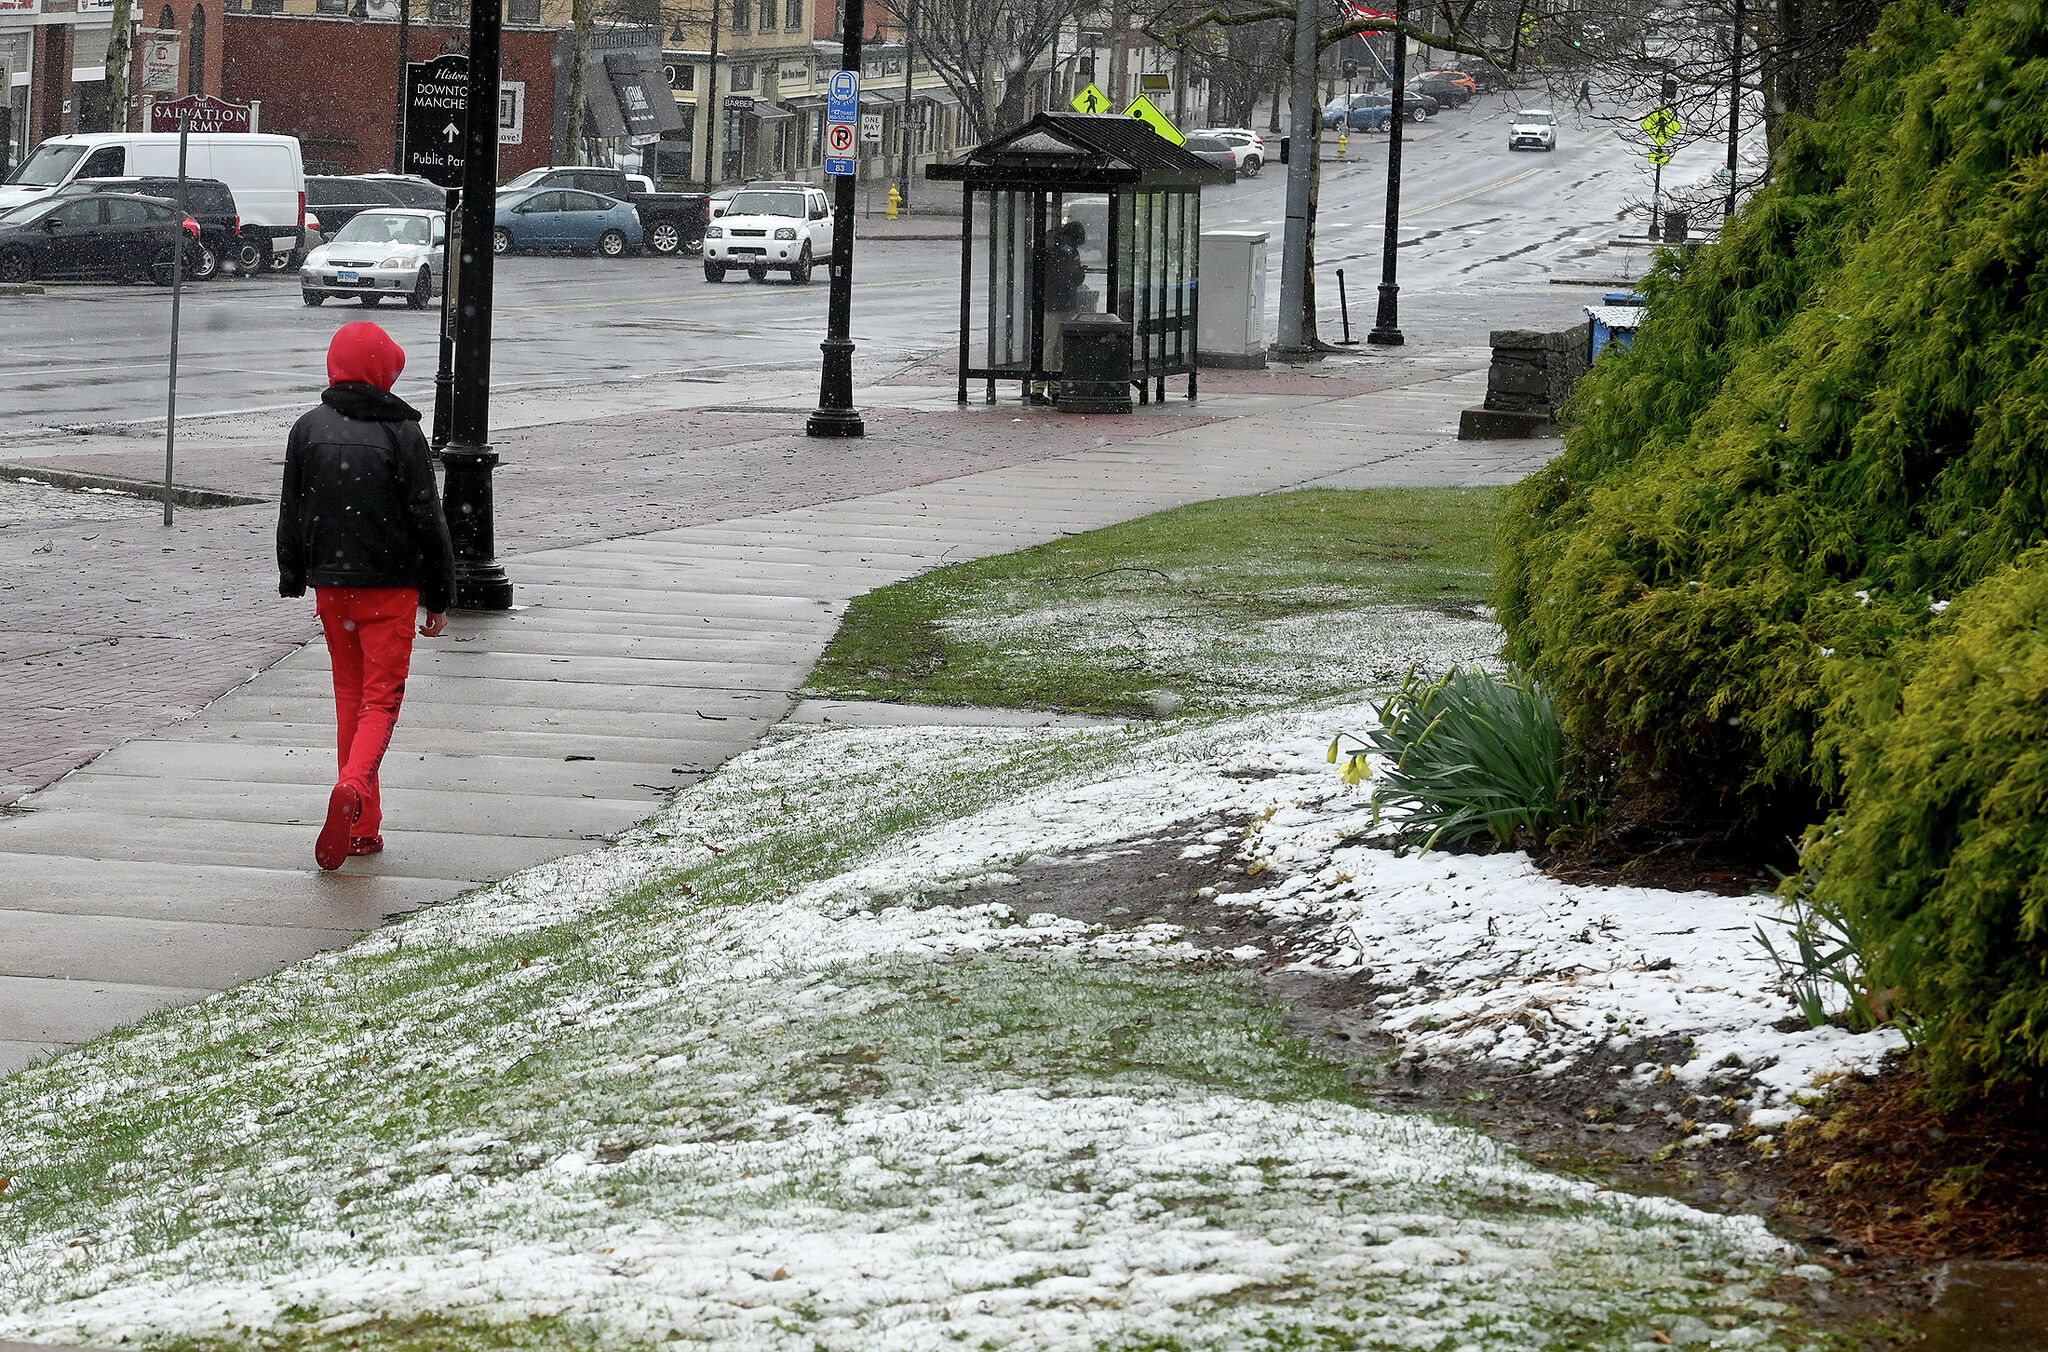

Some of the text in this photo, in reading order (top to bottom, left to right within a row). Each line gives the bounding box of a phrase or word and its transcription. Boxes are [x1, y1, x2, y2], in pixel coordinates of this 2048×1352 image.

[435, 68, 468, 80] Histori
[417, 83, 468, 97] DOWNTO
[195, 101, 208, 109] THE
[414, 97, 468, 110] MANCHE
[724, 100, 754, 108] BARBER
[830, 96, 856, 107] BUS STOP
[154, 106, 247, 122] SALVATION
[501, 134, 520, 142] ove!
[413, 152, 465, 167] Public Par
[835, 164, 845, 172] 83
